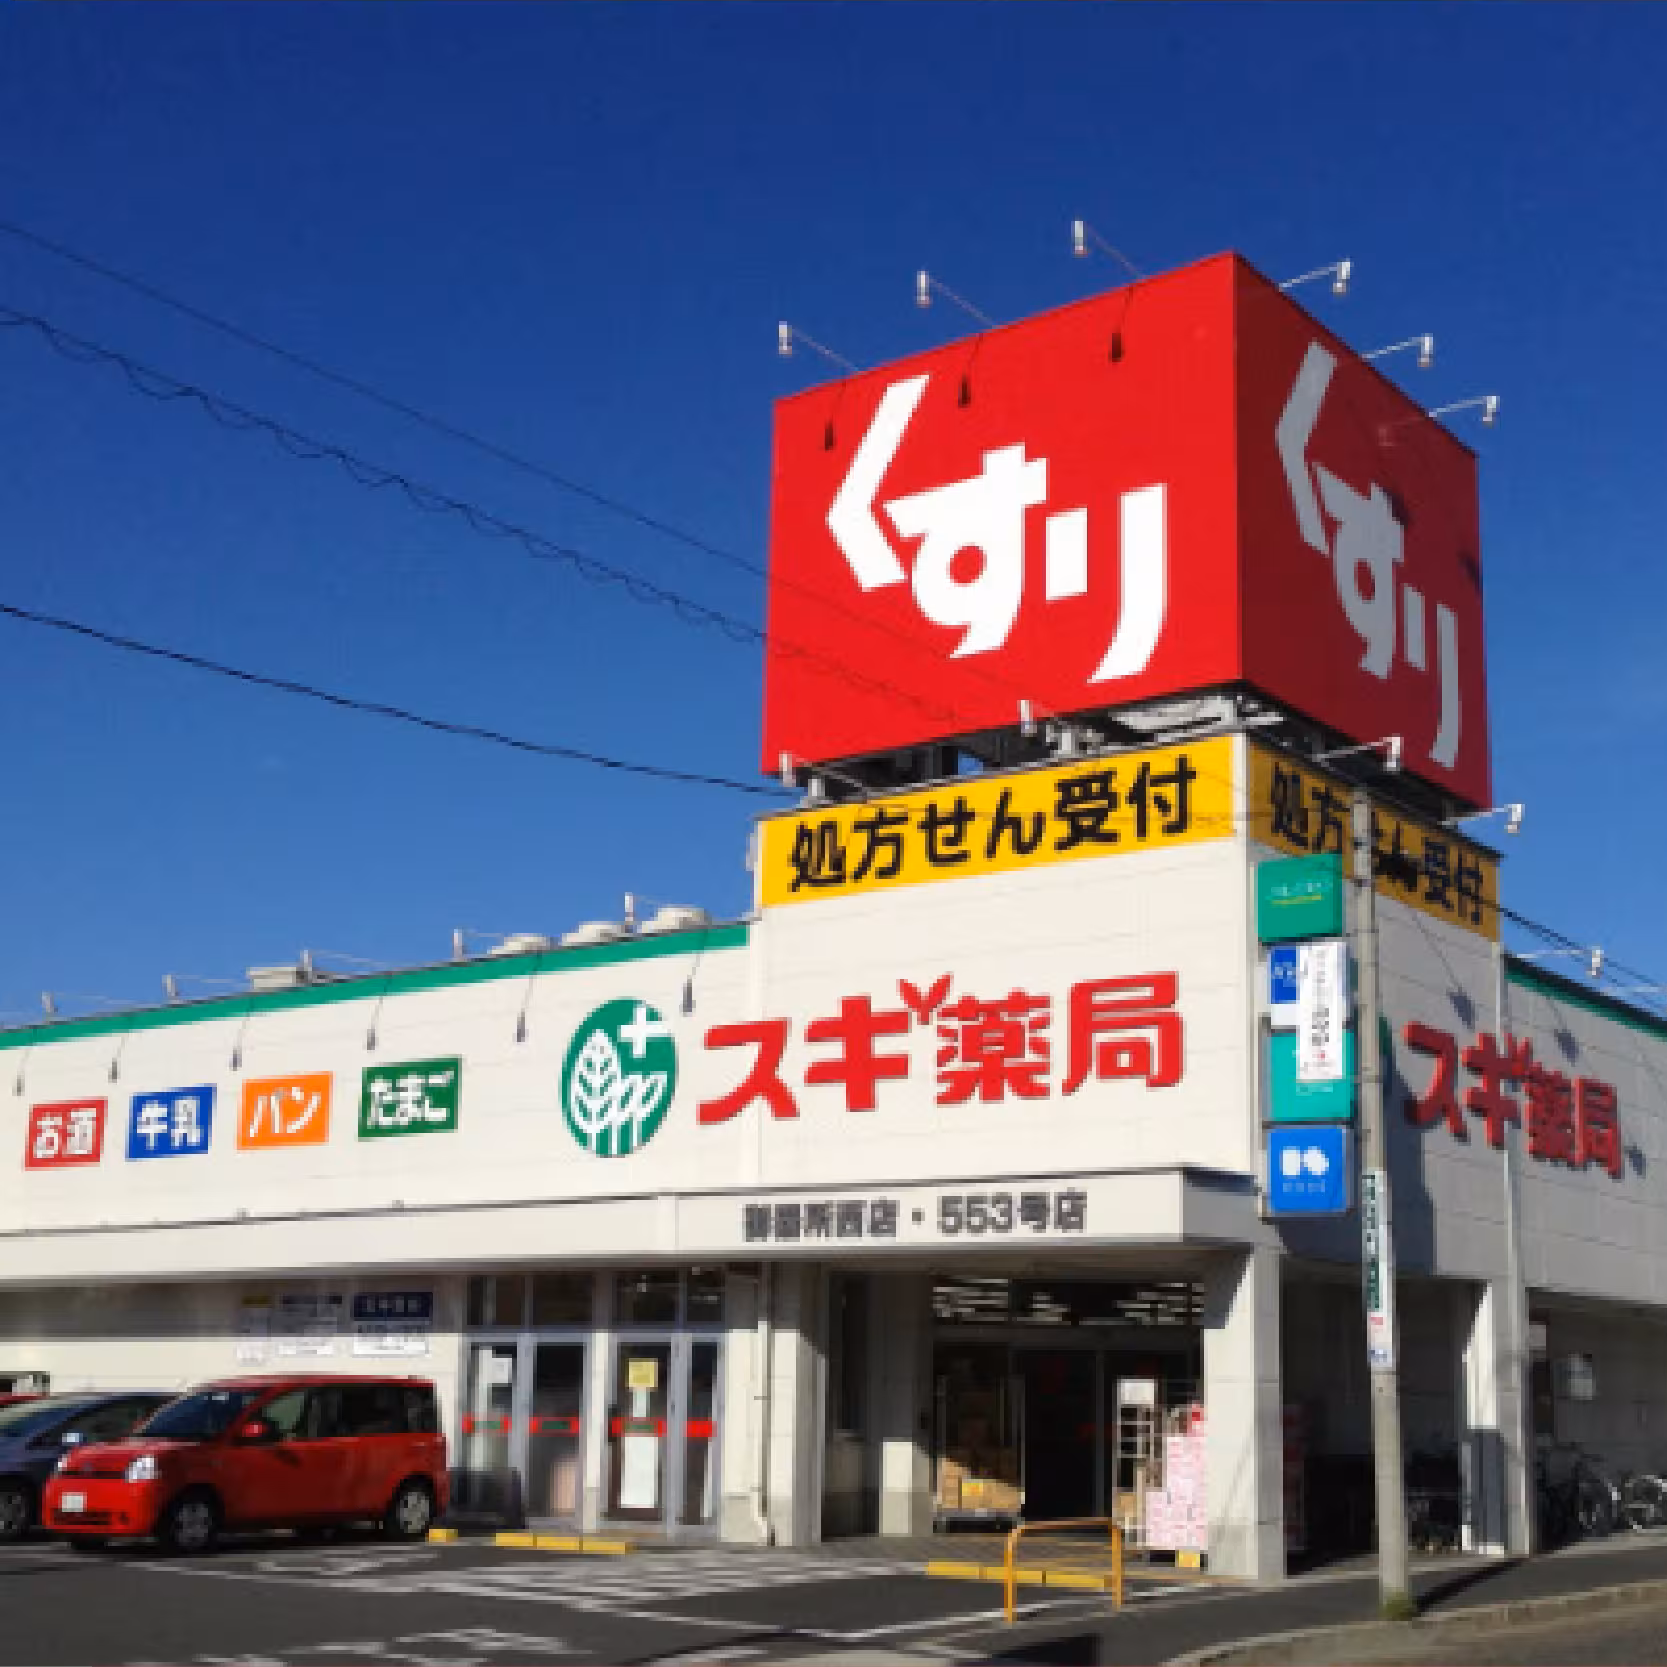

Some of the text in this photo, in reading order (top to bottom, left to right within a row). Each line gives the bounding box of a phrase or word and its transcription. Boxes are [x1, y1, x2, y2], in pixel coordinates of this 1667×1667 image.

[824, 374, 1169, 685] くすり
[1274, 340, 1460, 770] くすり
[789, 757, 1198, 894] 処方せん受付
[1271, 761, 1485, 926] 処方受付
[248, 1084, 323, 1139] パン
[367, 1069, 455, 1129] たまご
[695, 970, 1185, 1127] スギ薬局
[1403, 1021, 1624, 1180] スギ薬局
[33, 1108, 98, 1160] お酒
[135, 1097, 203, 1151] 牛乳
